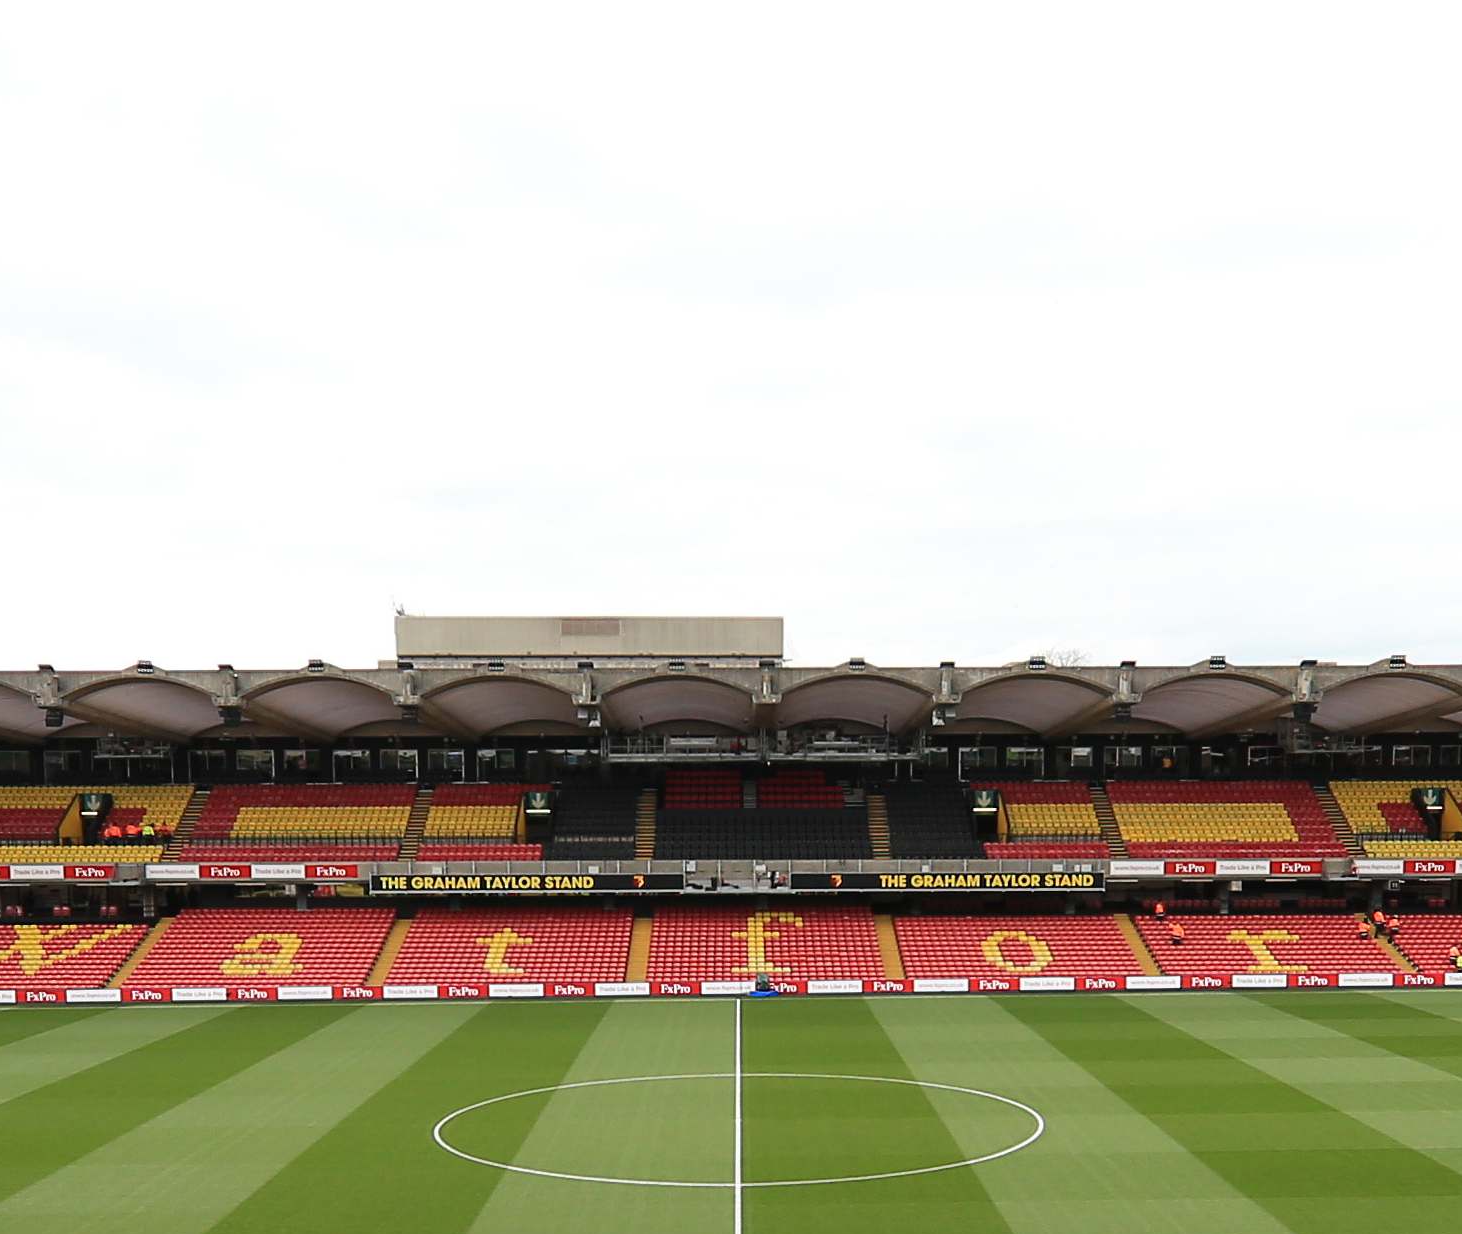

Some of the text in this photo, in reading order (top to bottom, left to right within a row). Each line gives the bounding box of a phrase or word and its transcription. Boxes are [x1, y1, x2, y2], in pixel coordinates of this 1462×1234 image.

[75, 868, 106, 877] FxPro
[210, 867, 241, 877] FxPro
[316, 867, 347, 876] FxPro
[1176, 863, 1206, 873] FxPro
[1282, 863, 1312, 873] FxPro
[1414, 863, 1445, 872] FxPro
[380, 876, 594, 889] THE GRAHAM TAYLOR STAND
[880, 874, 1094, 888] THE GRAHAM TAYLOR STAND
[1086, 978, 1116, 988] FxPro
[1192, 977, 1222, 987] FxPro
[1298, 976, 1328, 986] FxPro
[1404, 974, 1434, 984] FxPro
[554, 985, 585, 995] FxPro
[660, 984, 691, 994] FxPro
[874, 981, 904, 991] FxPro
[980, 980, 1010, 990] FxPro
[26, 991, 57, 1001] FxPro
[132, 990, 162, 1000] FxPro
[238, 989, 268, 999] FxPro
[343, 988, 374, 998] FxPro
[448, 986, 479, 996] FxPro
